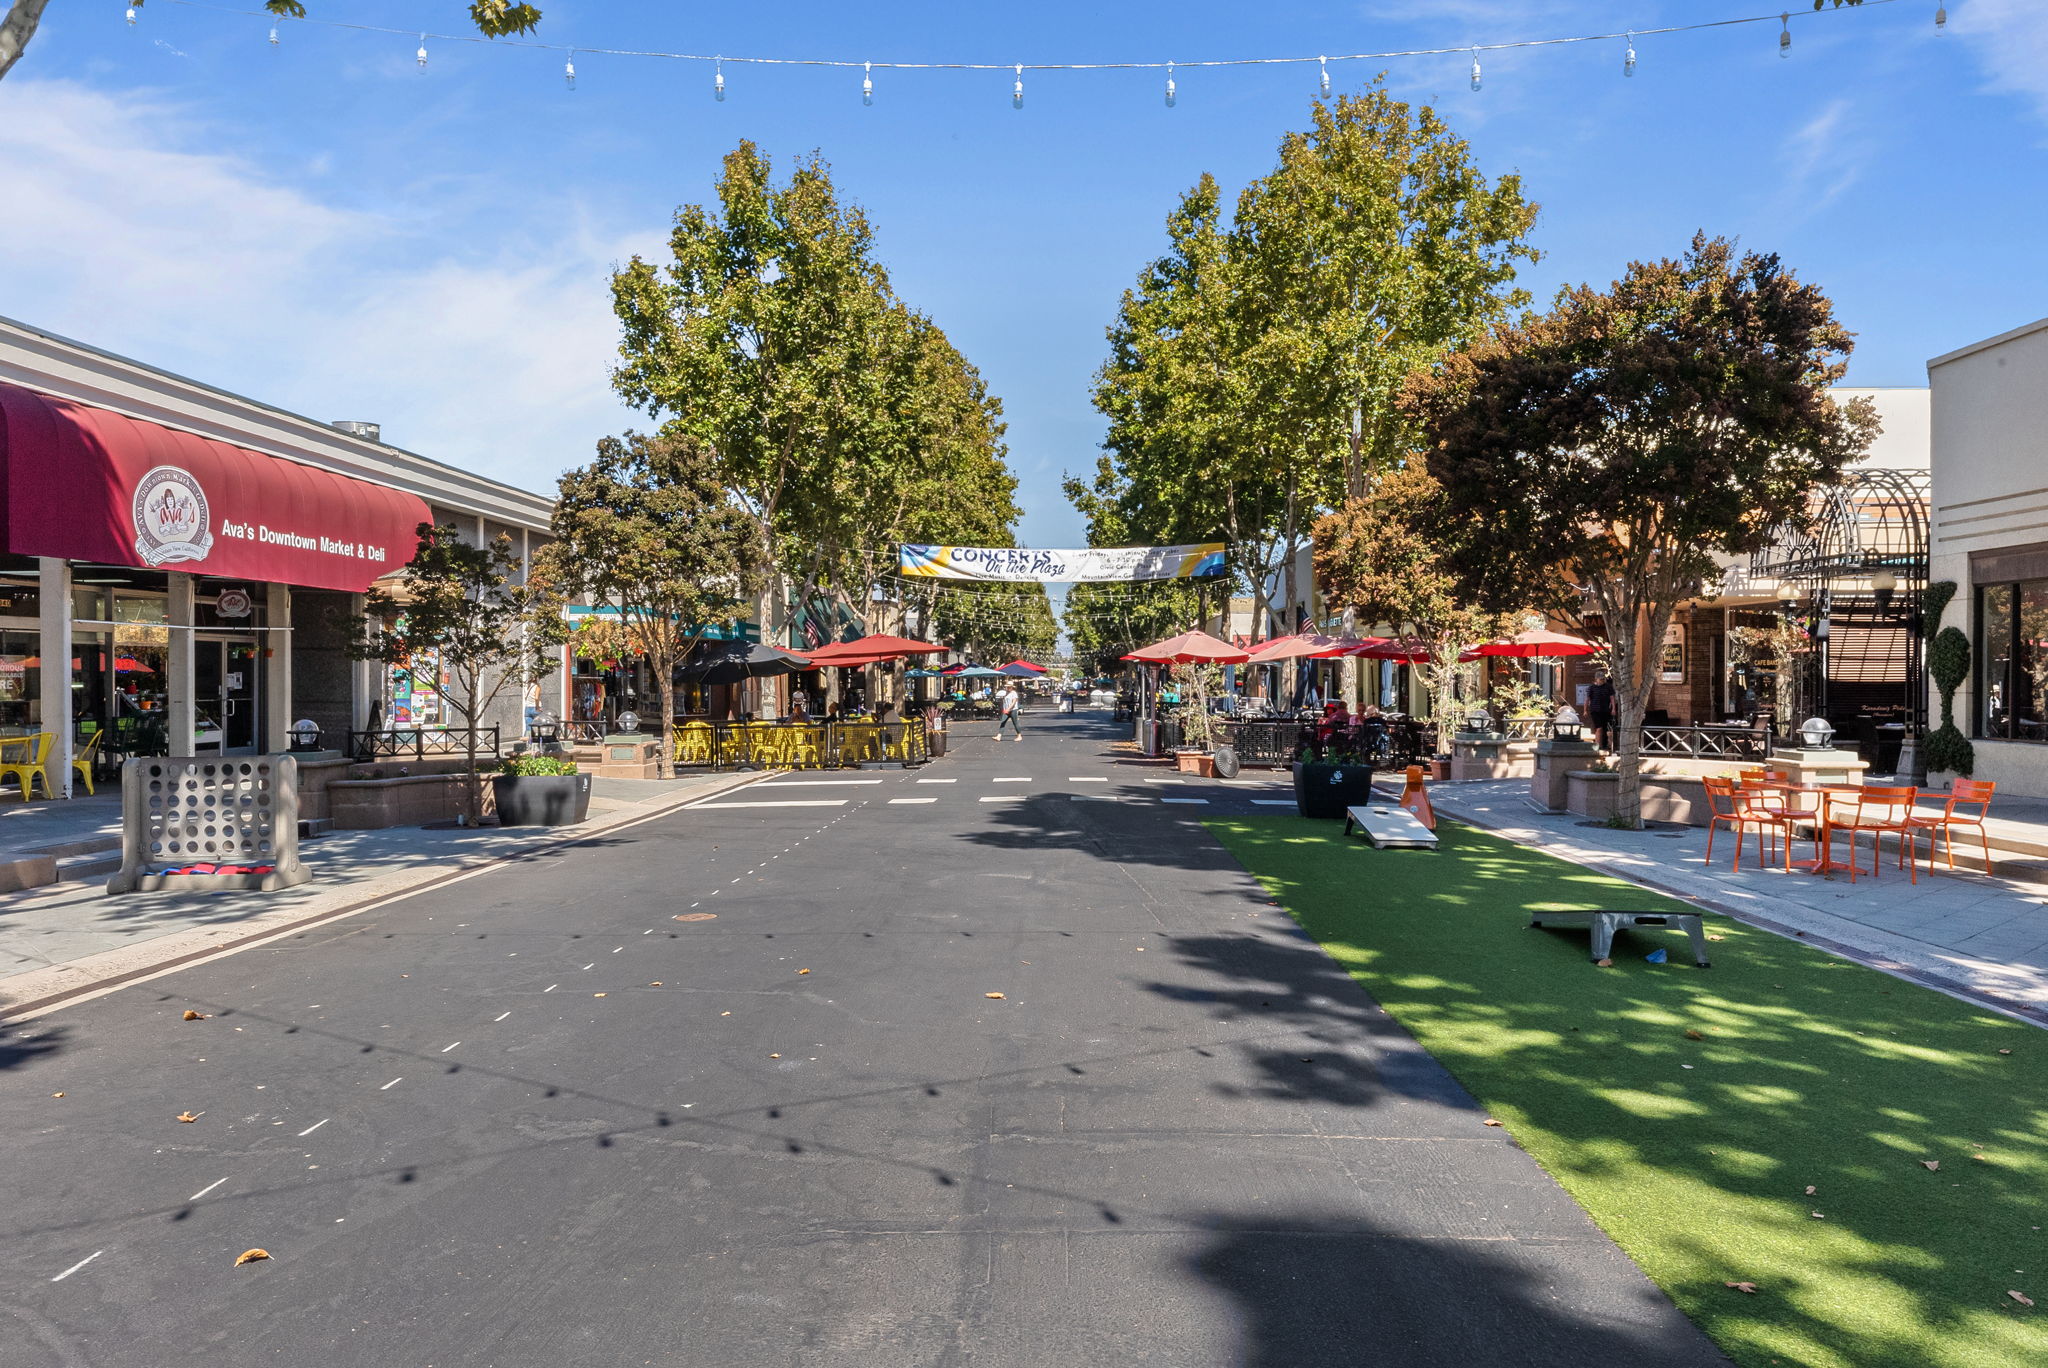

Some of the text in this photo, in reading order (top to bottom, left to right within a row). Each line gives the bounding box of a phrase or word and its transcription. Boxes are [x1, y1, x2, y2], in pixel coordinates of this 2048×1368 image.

[222, 519, 255, 540] Ava's
[259, 525, 317, 550] Downtown
[320, 536, 354, 557] Market
[357, 543, 365, 559] &
[368, 545, 385, 562] Deli
[951, 548, 1052, 563] CONCERTS
[985, 559, 1066, 577] On the Plaza
